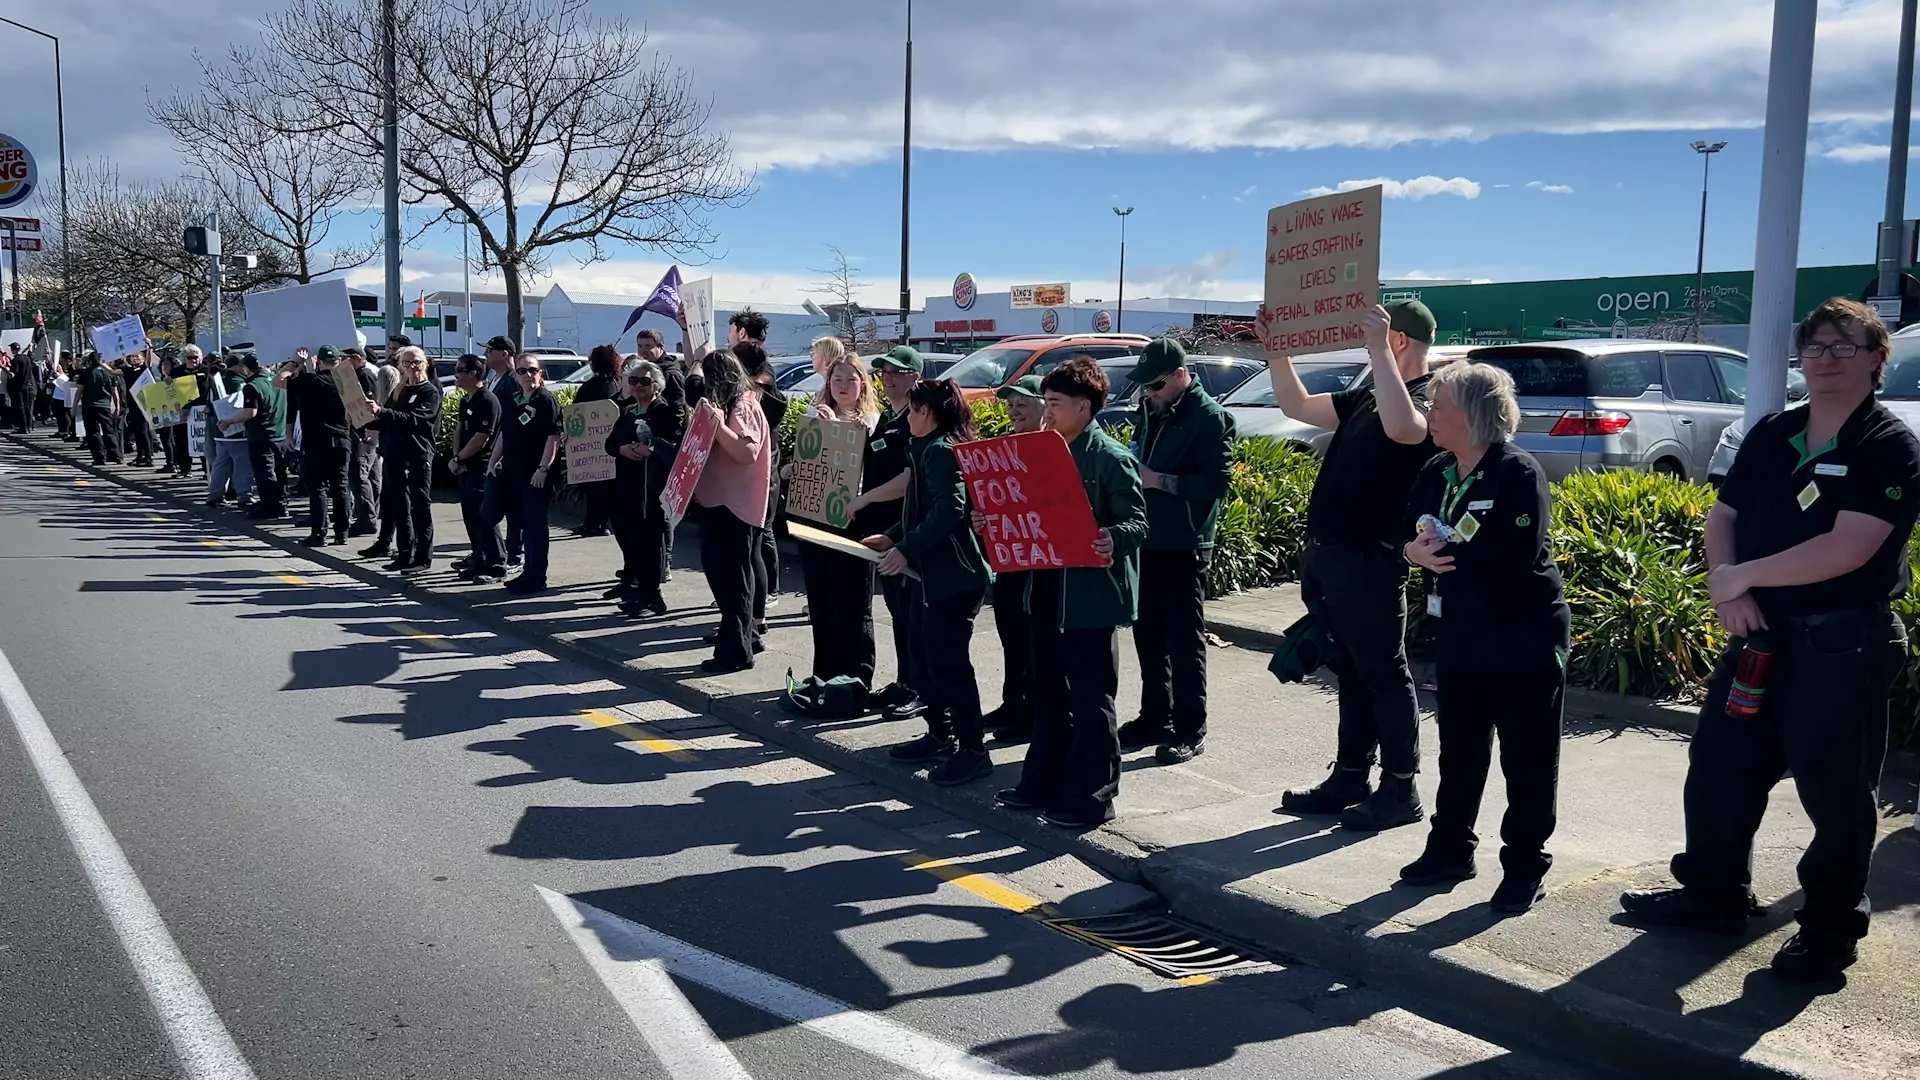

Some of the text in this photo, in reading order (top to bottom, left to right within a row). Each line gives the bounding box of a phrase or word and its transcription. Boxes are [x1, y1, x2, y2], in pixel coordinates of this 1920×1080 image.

[0, 149, 24, 161] GER
[0, 161, 27, 180] NG
[1286, 201, 1364, 233] LIVING WAGE
[1278, 232, 1364, 265] SAFER STAFFING
[1300, 266, 1336, 290] LEVELS
[1276, 305, 1310, 323] PENAL
[1314, 296, 1342, 315] RATES
[1346, 292, 1367, 310] FOR
[1597, 290, 1670, 317] open
[591, 411, 600, 420] ON
[588, 424, 613, 436] STRIKE
[570, 441, 602, 453] UNDERPAID
[956, 439, 1028, 475] HONK
[792, 460, 845, 486] DESERVE
[789, 478, 826, 499] BETTER
[973, 475, 1028, 510] FOR
[789, 492, 822, 513] WAGES
[985, 511, 1049, 541] FAIR
[994, 542, 1064, 566] DEAL
